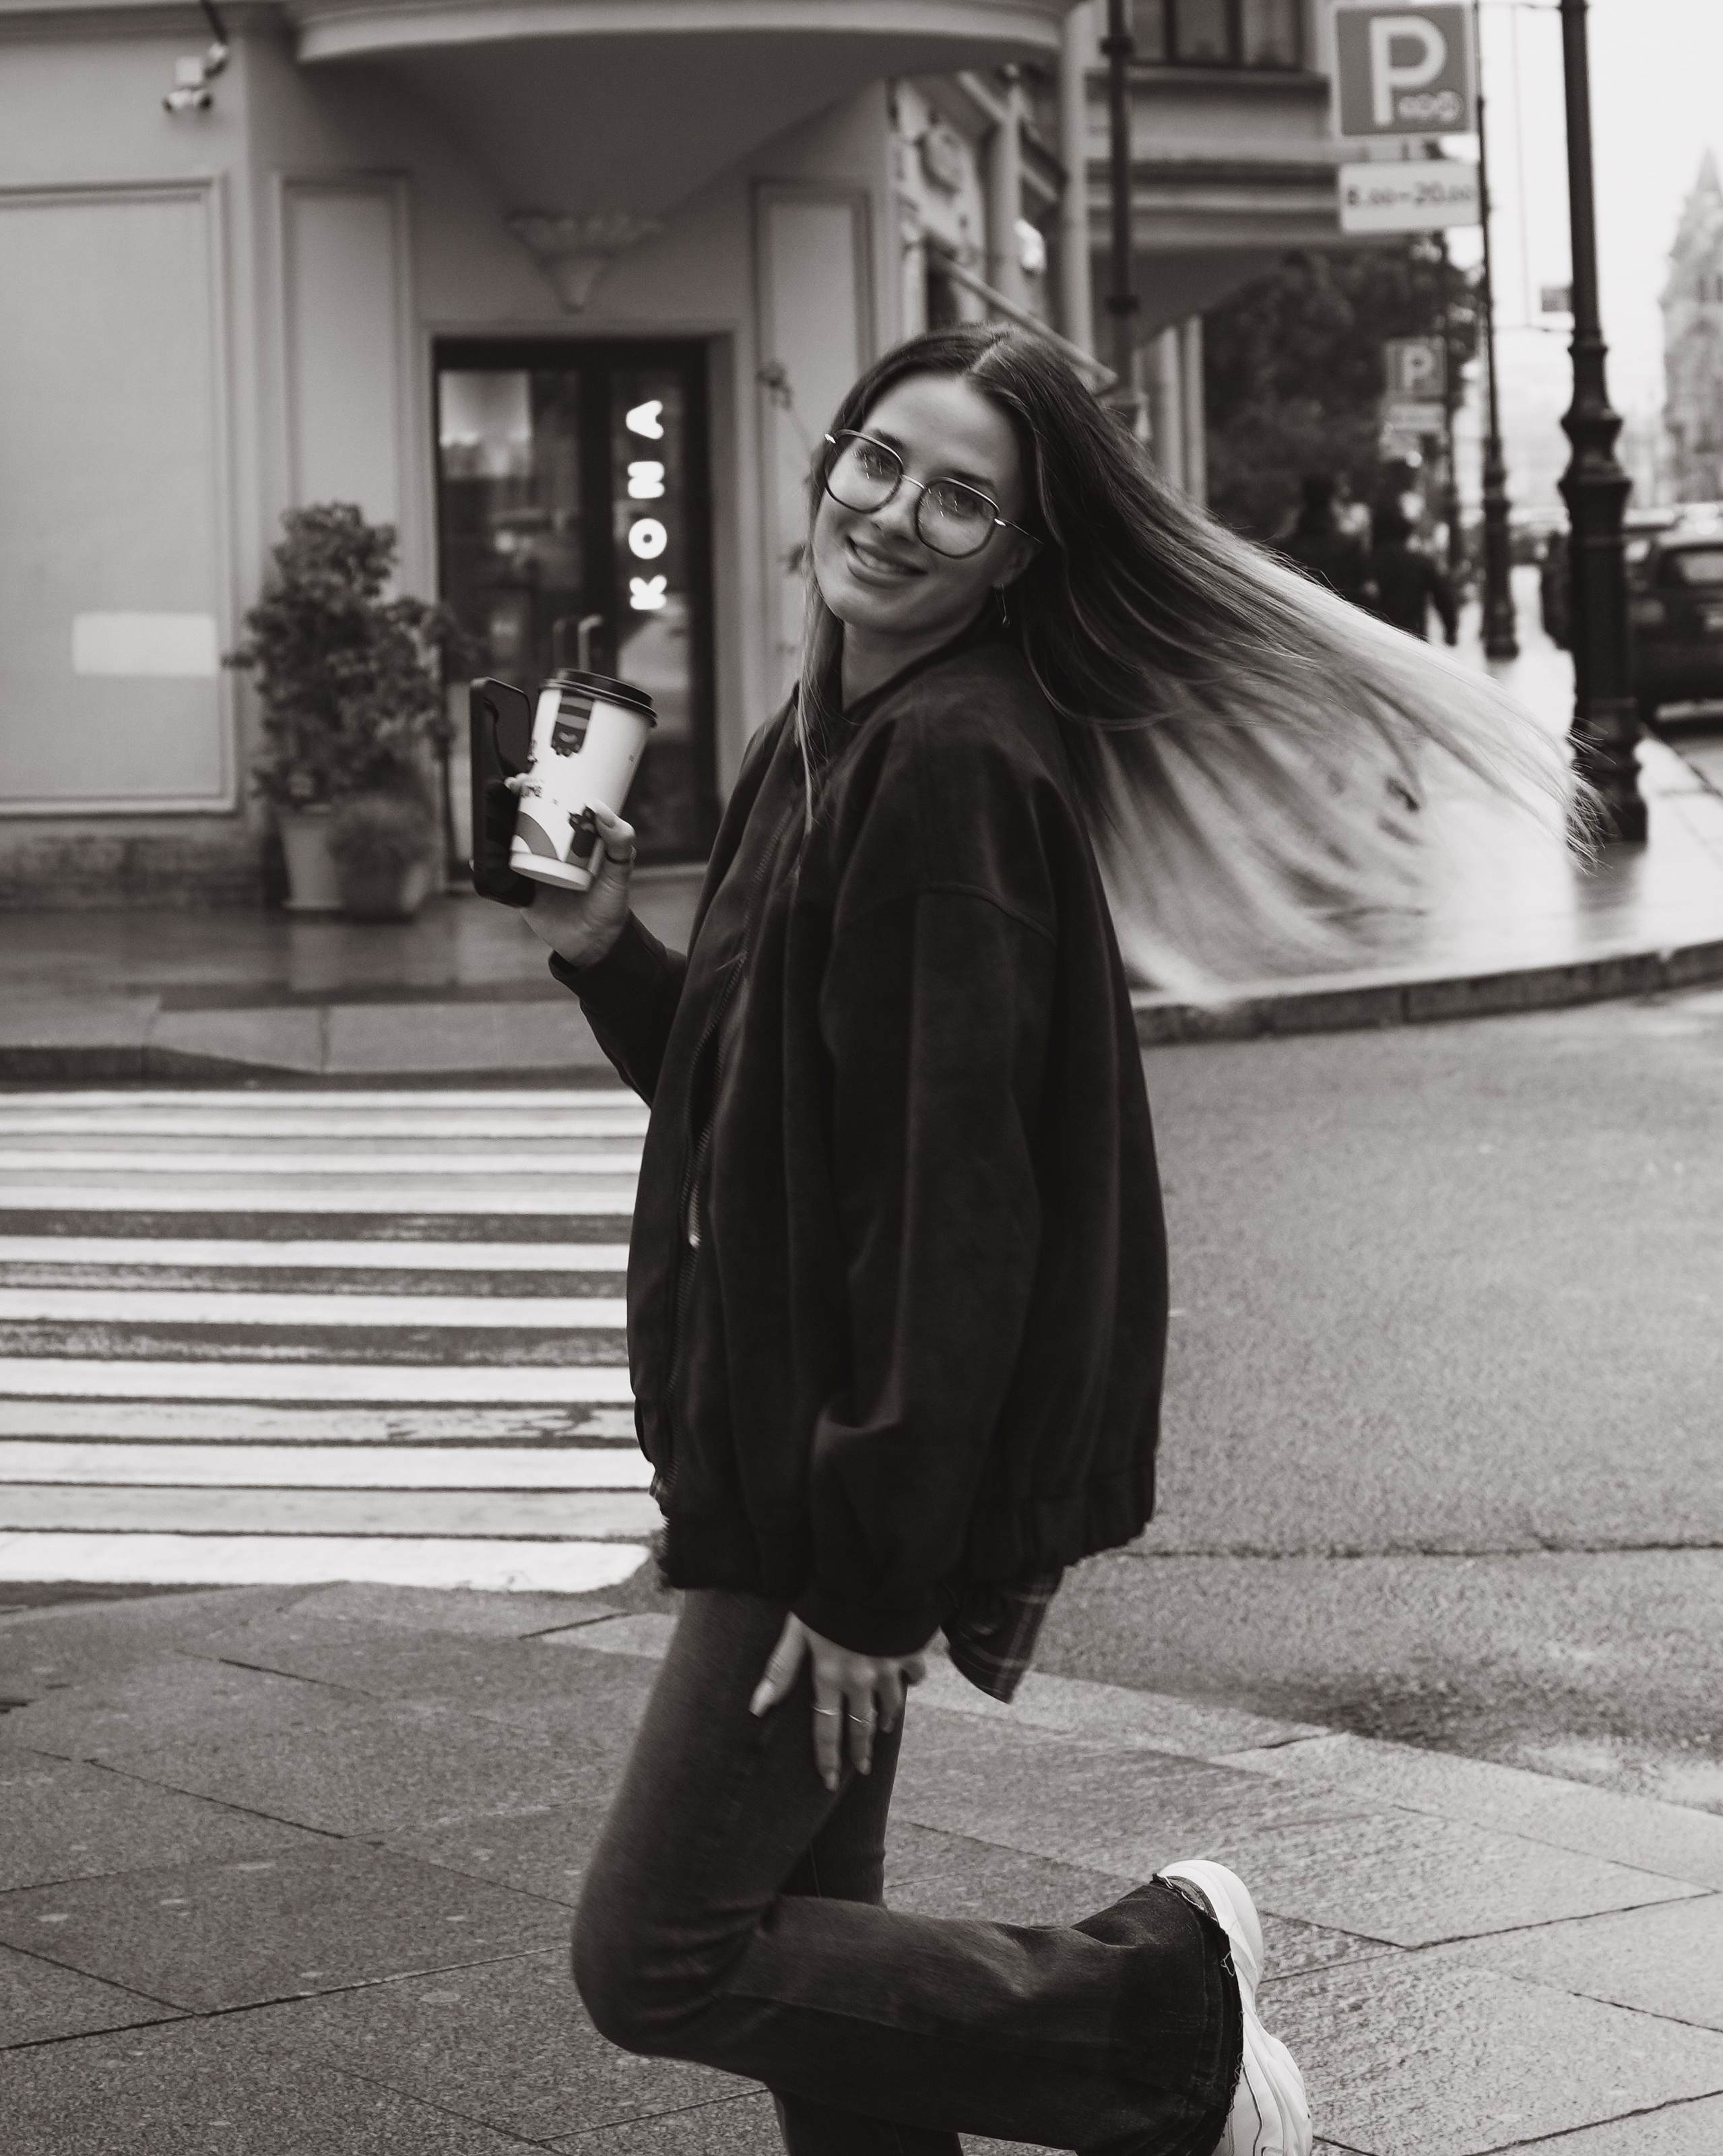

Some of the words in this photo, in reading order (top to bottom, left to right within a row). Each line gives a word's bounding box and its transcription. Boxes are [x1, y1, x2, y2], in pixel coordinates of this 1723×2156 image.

[1369, 15, 1447, 127] P
[1401, 344, 1434, 390] P
[625, 399, 668, 610] KONA
